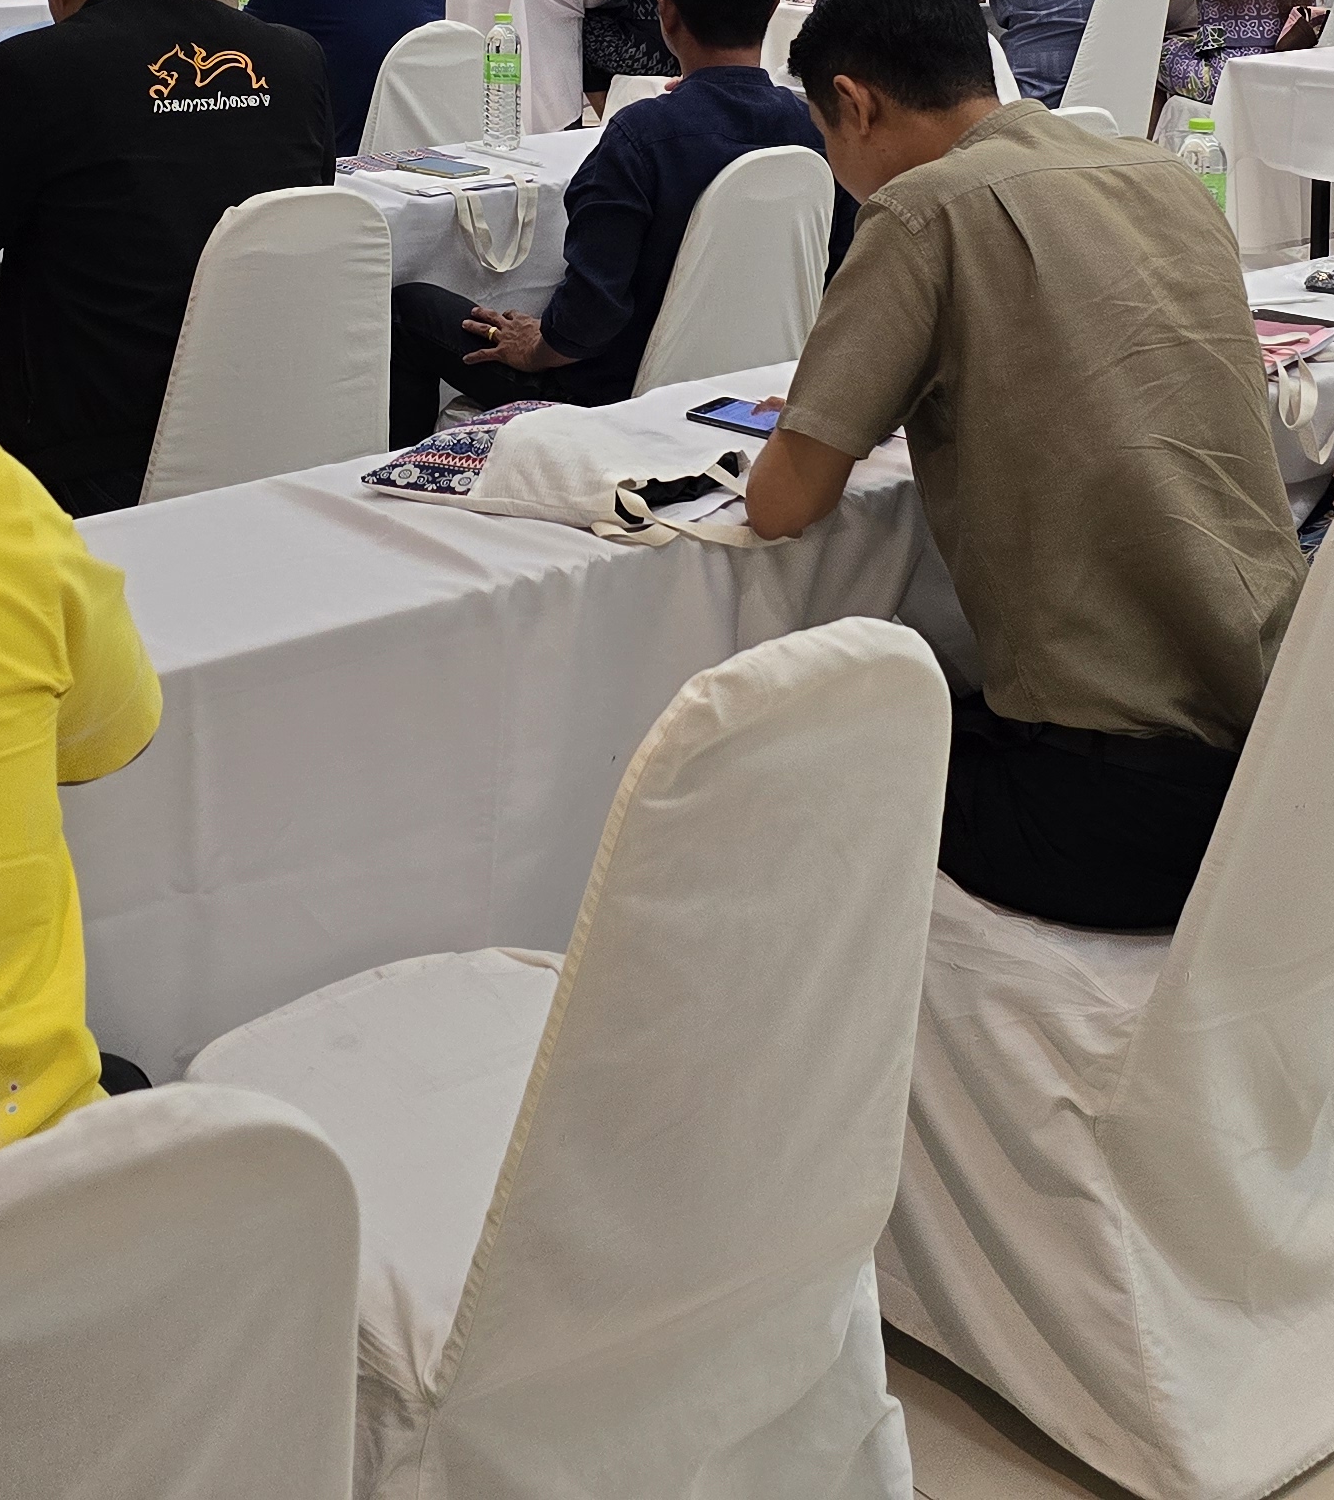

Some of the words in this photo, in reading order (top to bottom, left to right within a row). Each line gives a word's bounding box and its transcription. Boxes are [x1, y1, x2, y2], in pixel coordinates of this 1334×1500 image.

[154, 91, 271, 113] กรมการปกครอง
